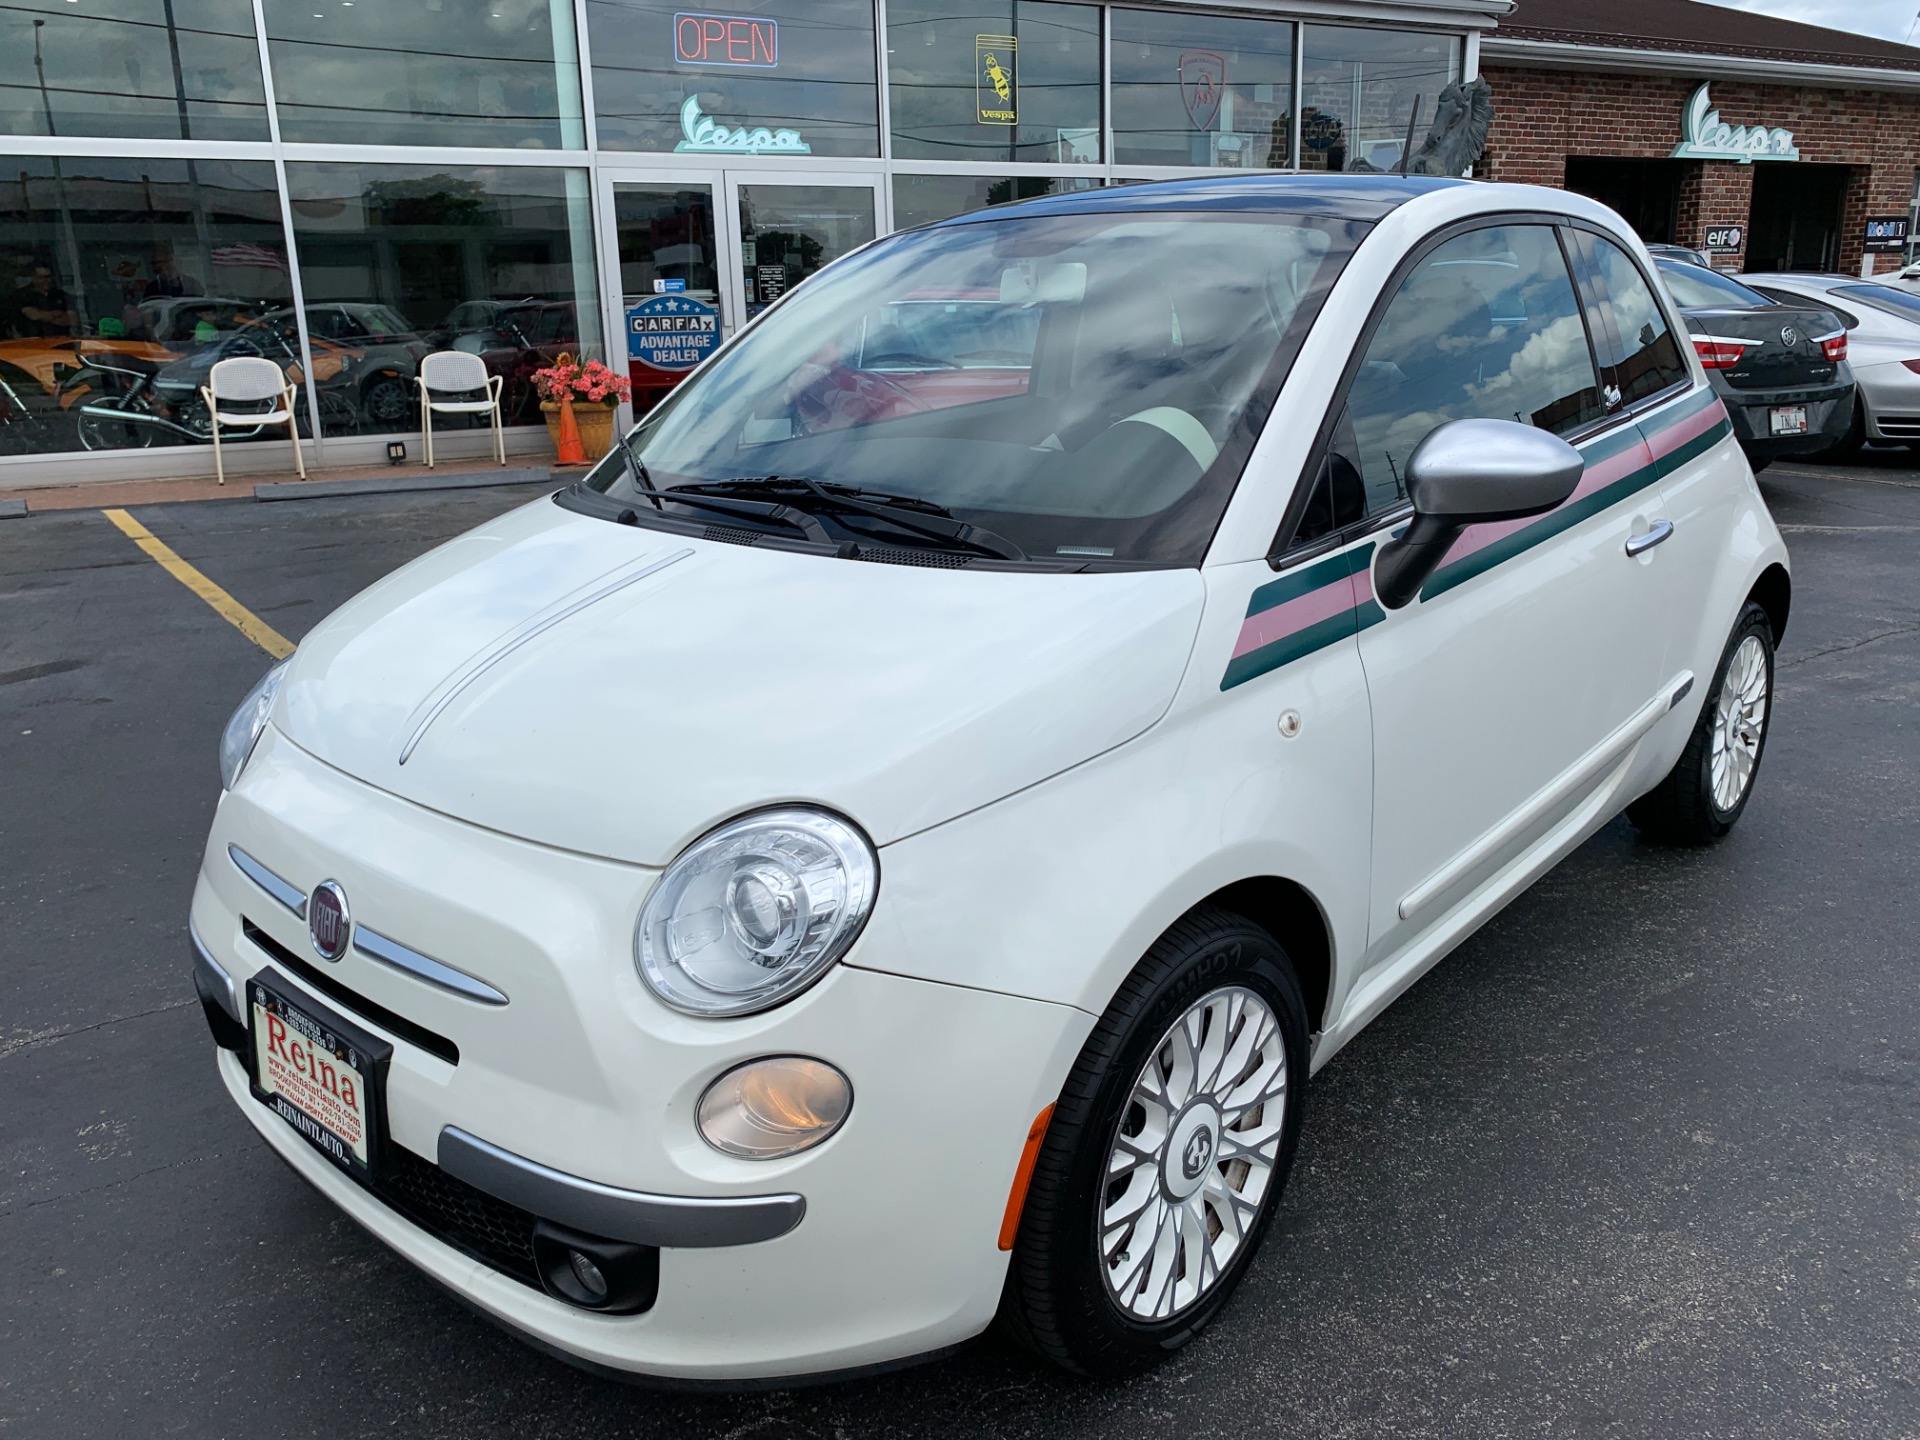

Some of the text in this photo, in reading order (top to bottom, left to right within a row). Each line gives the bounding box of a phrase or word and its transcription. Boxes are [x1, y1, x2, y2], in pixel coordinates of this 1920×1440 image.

[678, 17, 774, 63] OPEN
[980, 109, 1016, 121] Vespa
[1682, 81, 1798, 162] Vespa
[678, 94, 806, 154] Vespa
[1867, 221, 1896, 237] Mobil
[1707, 230, 1729, 245] elf
[633, 318, 713, 332] CARFAX
[640, 335, 711, 348] ADVANTAGE
[653, 349, 700, 363] DEALER
[316, 901, 340, 943] FIAT
[265, 1012, 359, 1114] Reina
